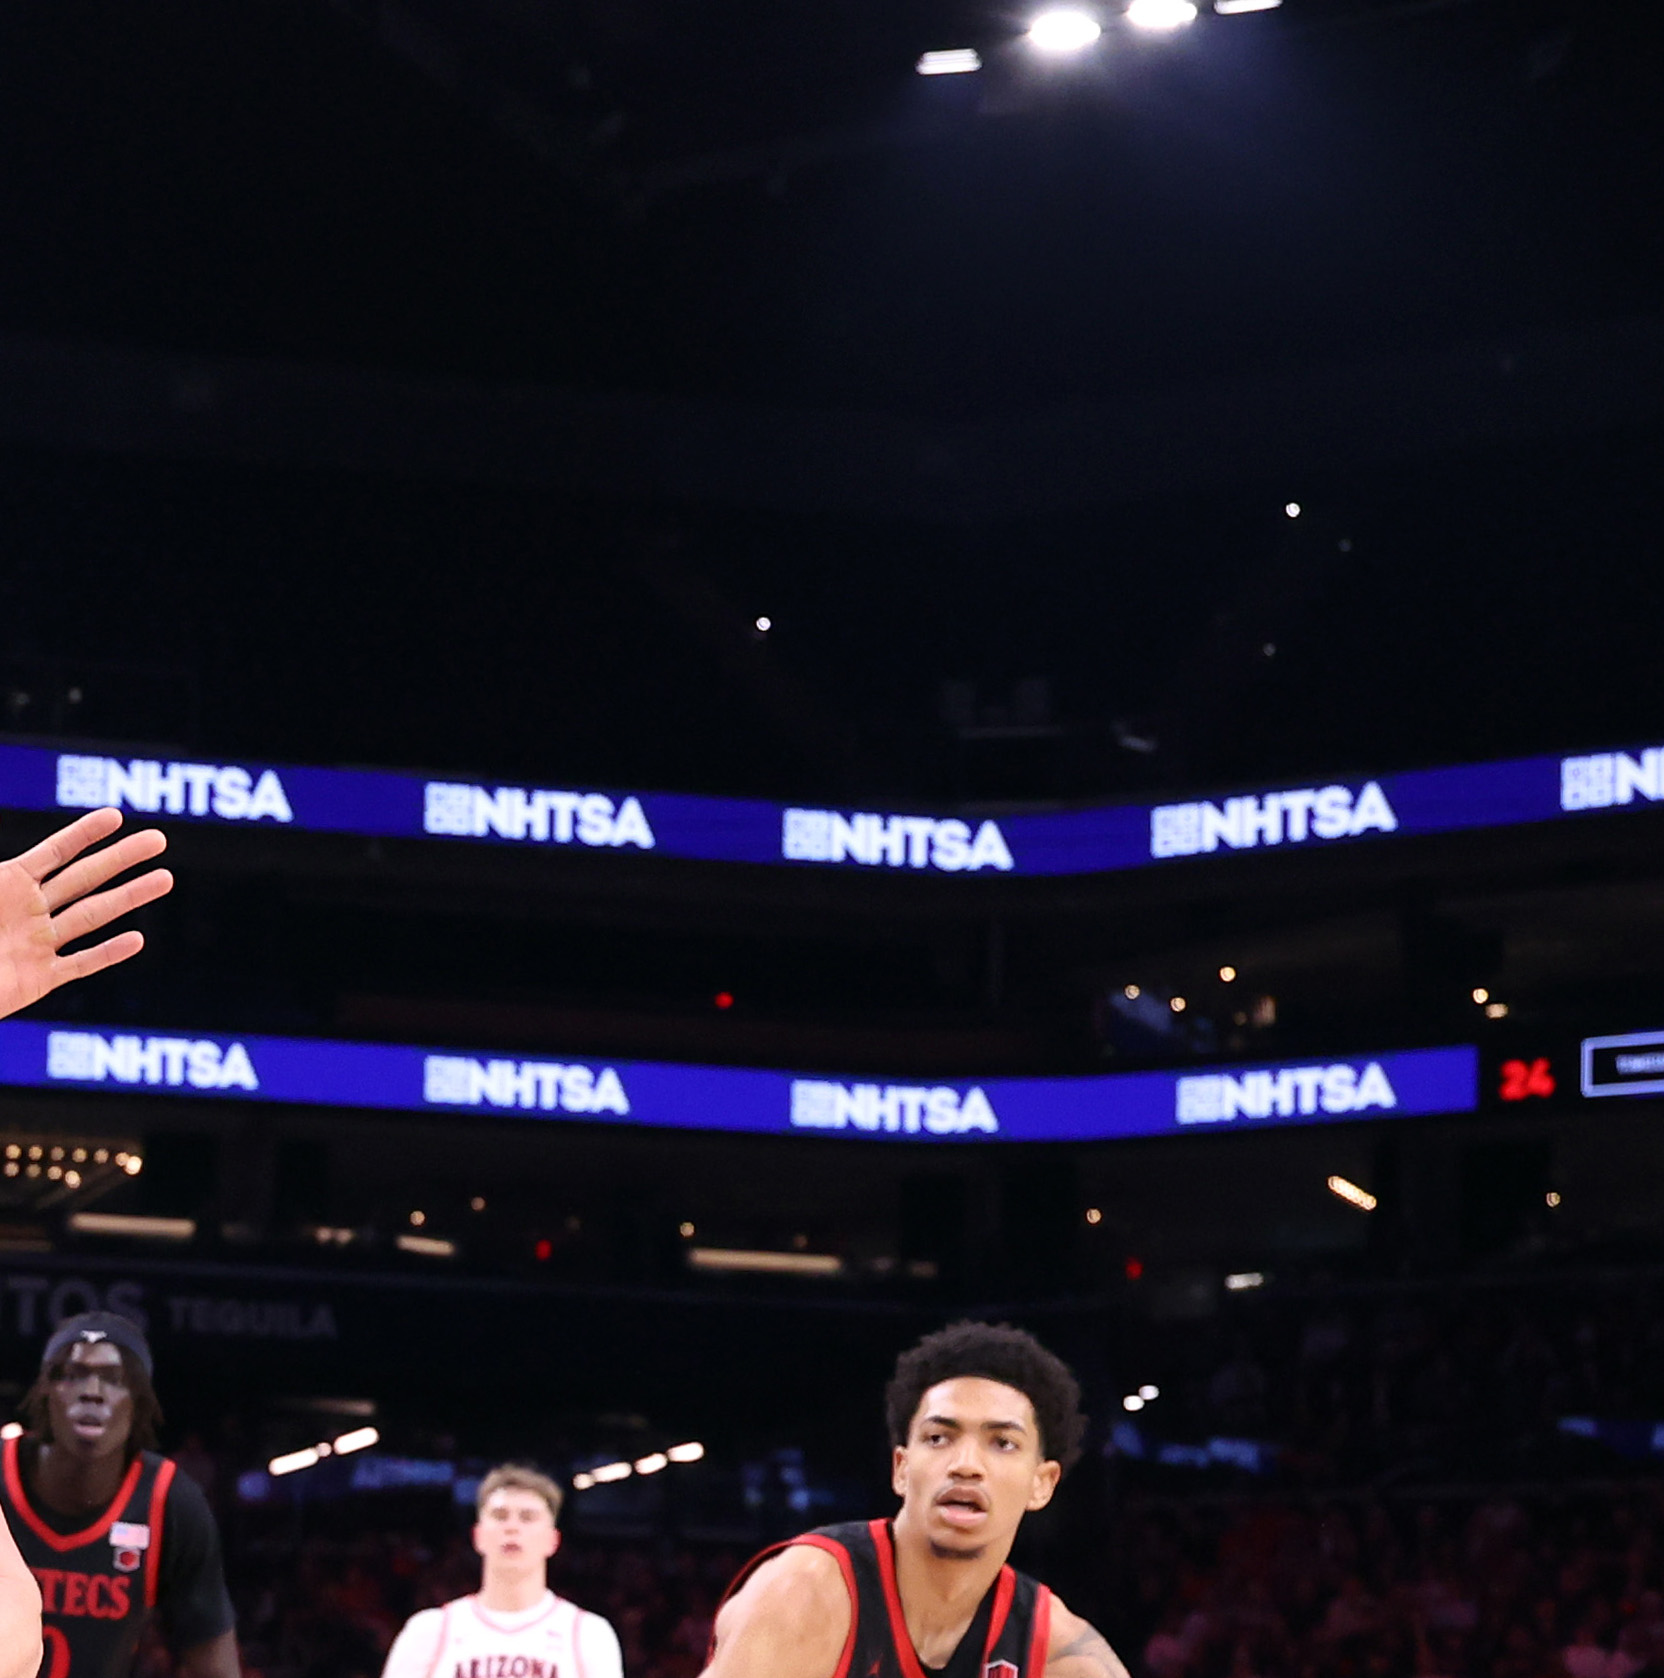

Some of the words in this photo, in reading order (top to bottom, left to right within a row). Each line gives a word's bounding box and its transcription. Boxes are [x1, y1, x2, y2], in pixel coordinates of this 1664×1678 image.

[108, 765, 293, 823] NHTSA
[474, 787, 654, 849] NHTSA
[1200, 782, 1398, 852] NHTSA
[831, 812, 1014, 871] NHTSA
[92, 1033, 259, 1091] NHTSA
[475, 1060, 630, 1115] NHTSA
[833, 1083, 999, 1134] NHTSA
[1223, 1062, 1397, 1121] NHTSA
[173, 1298, 339, 1341] TEQUILA
[32, 1567, 131, 1620] TECS
